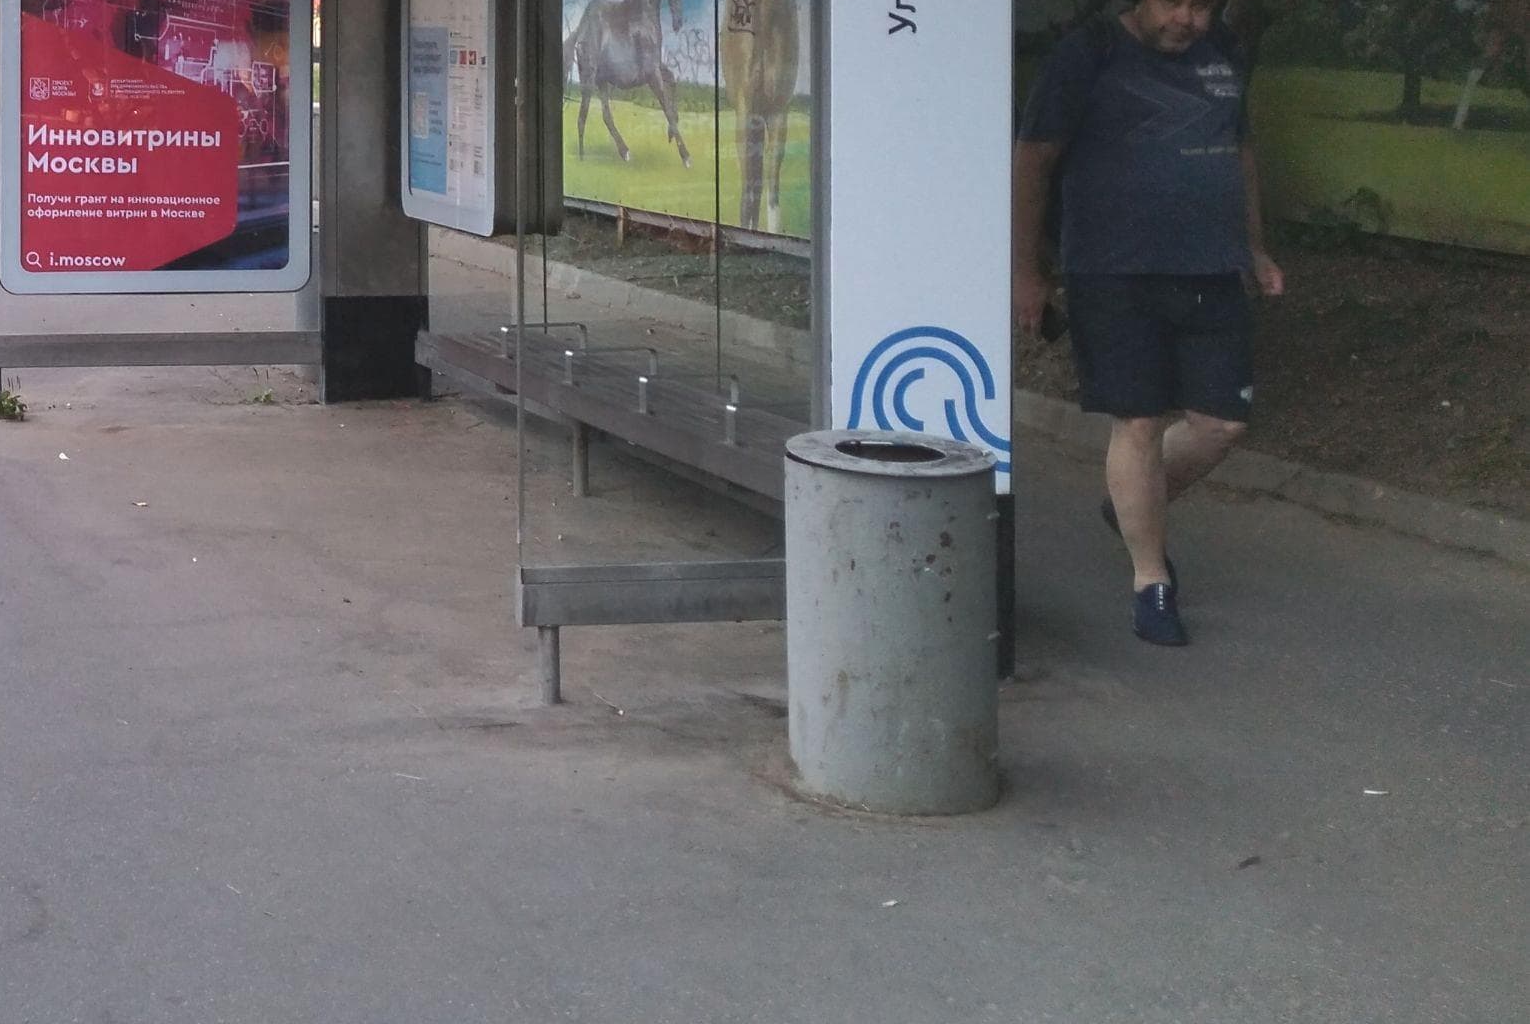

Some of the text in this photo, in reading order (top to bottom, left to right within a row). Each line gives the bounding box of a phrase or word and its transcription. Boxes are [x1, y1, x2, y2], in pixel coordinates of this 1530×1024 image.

[28, 124, 221, 151] Инновитрины
[27, 152, 137, 173] Москвы
[27, 193, 221, 207] Получи грант на инновационное
[27, 206, 206, 220] оформление витрин в Москве
[49, 252, 126, 267] i.moscow
